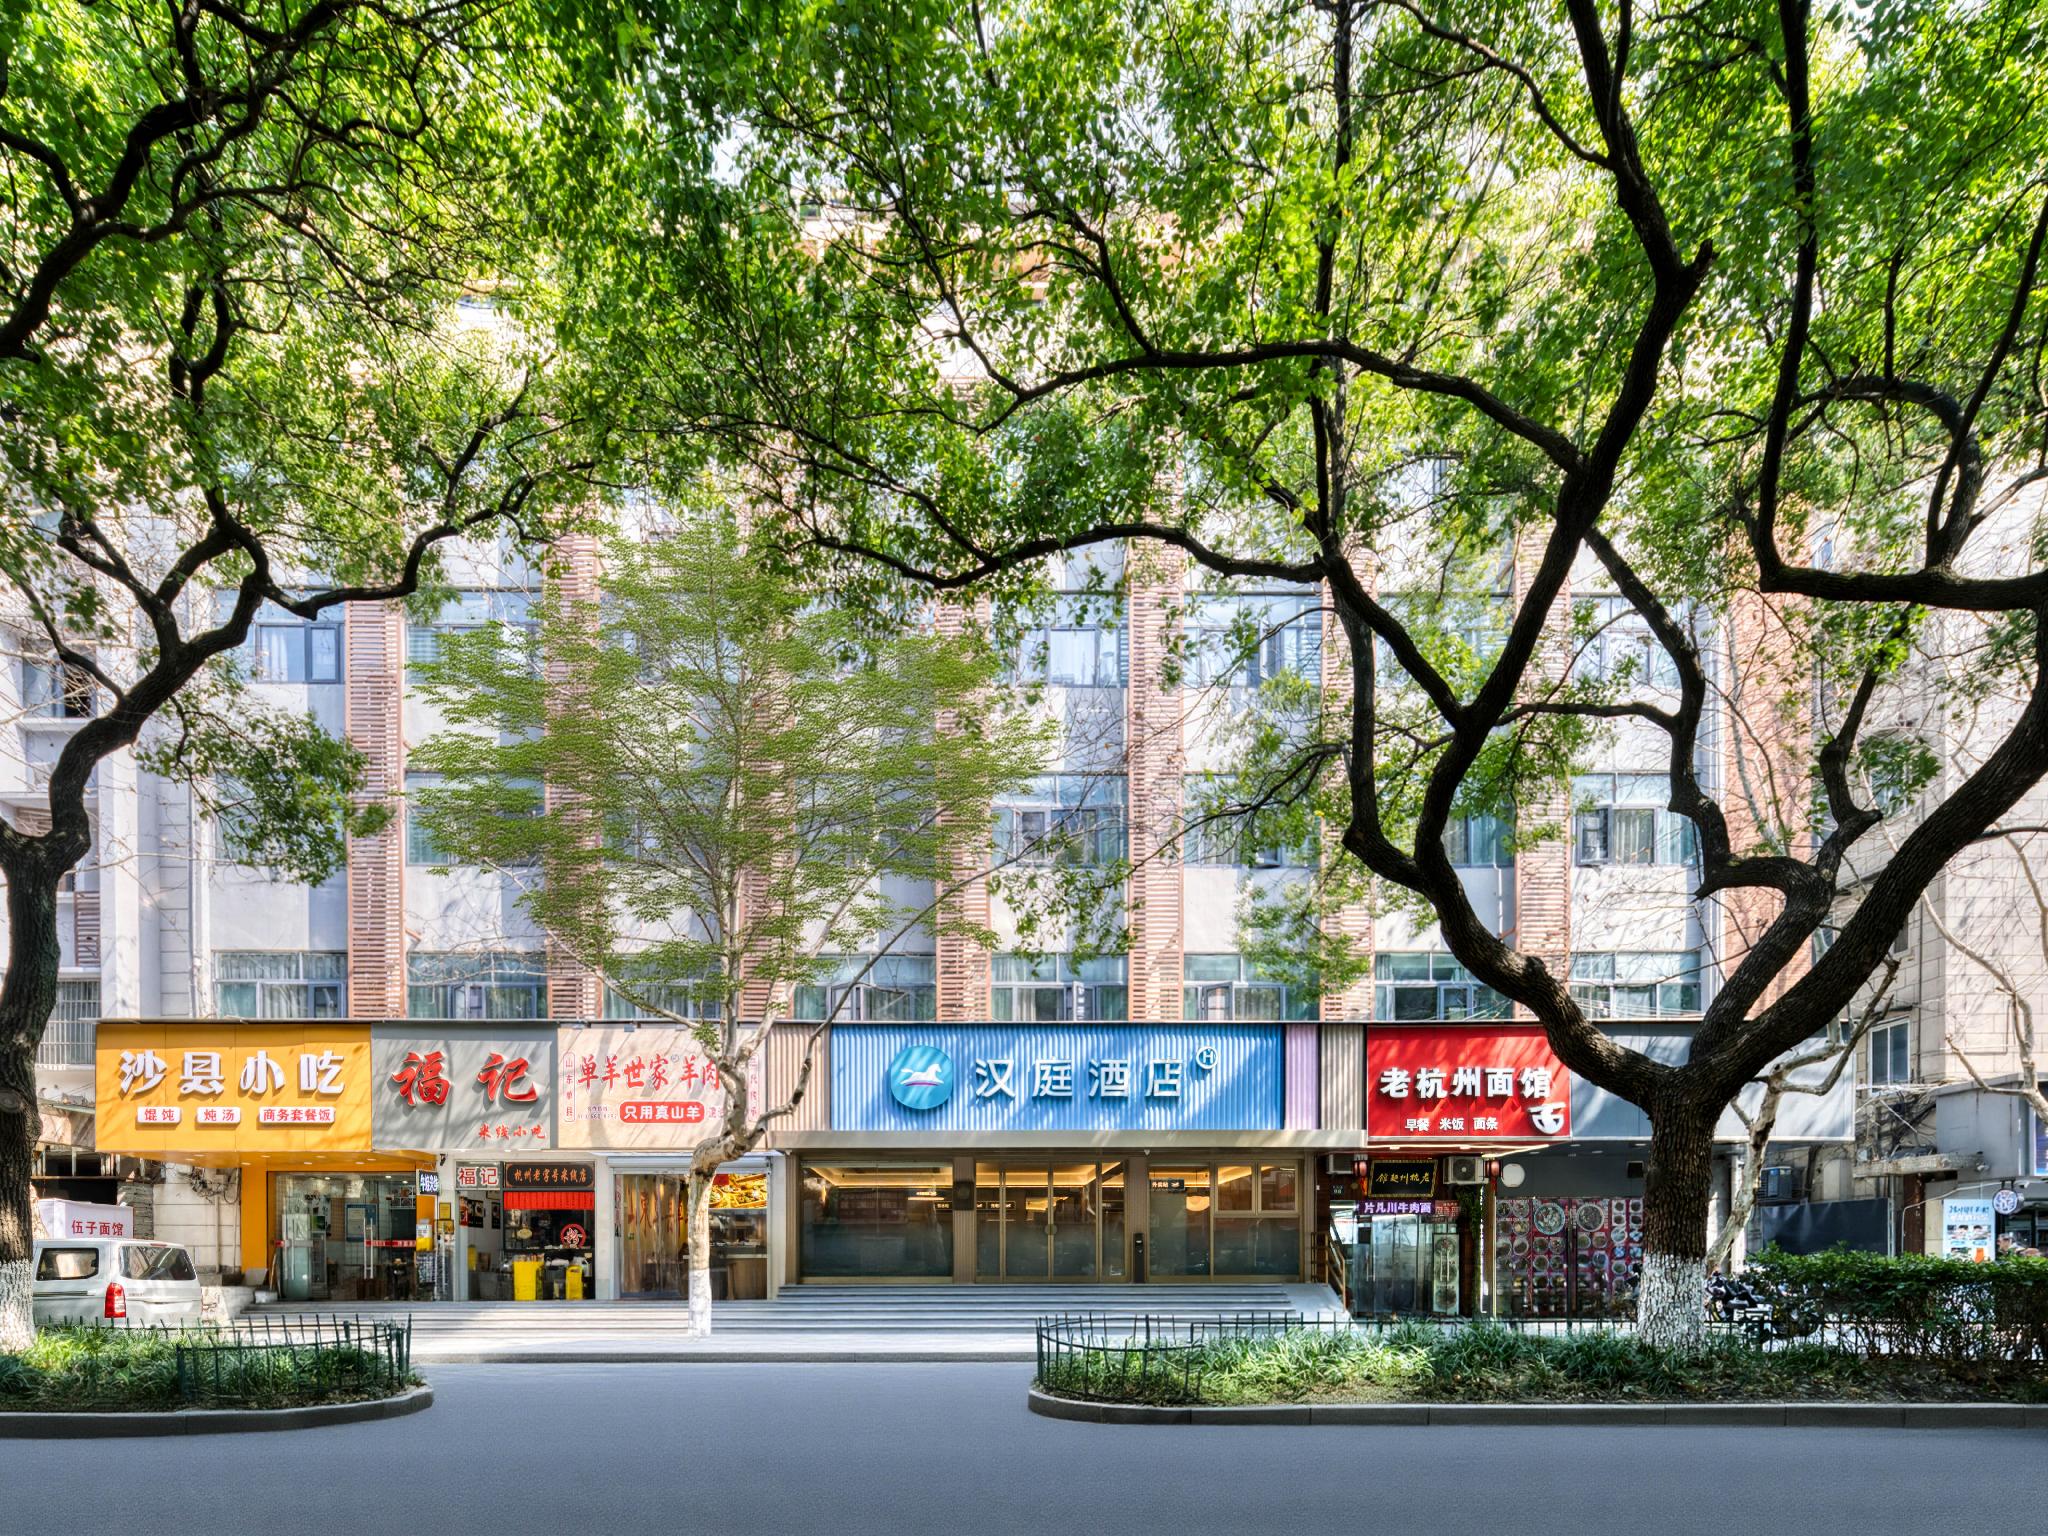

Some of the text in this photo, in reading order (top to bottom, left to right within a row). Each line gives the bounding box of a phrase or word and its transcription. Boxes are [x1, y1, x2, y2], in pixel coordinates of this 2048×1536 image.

[119, 1049, 345, 1095] 沙县小吃
[391, 1050, 540, 1107] 福记
[577, 1053, 669, 1092] 单羊世家
[975, 1058, 1183, 1098] 汉庭酒店
[1380, 1066, 1553, 1099] 老杭州面馆
[144, 1108, 331, 1122] 馄饨 炖汤 商务套餐饭
[623, 1104, 701, 1120] 只用真山羊
[478, 1124, 546, 1140] 米线小吃
[1405, 1117, 1499, 1132] 早餐 米饭 面条
[458, 1167, 498, 1186] 福记
[514, 1167, 587, 1183] 杭州老字号米线店
[71, 1220, 124, 1236] 伍子面馆
